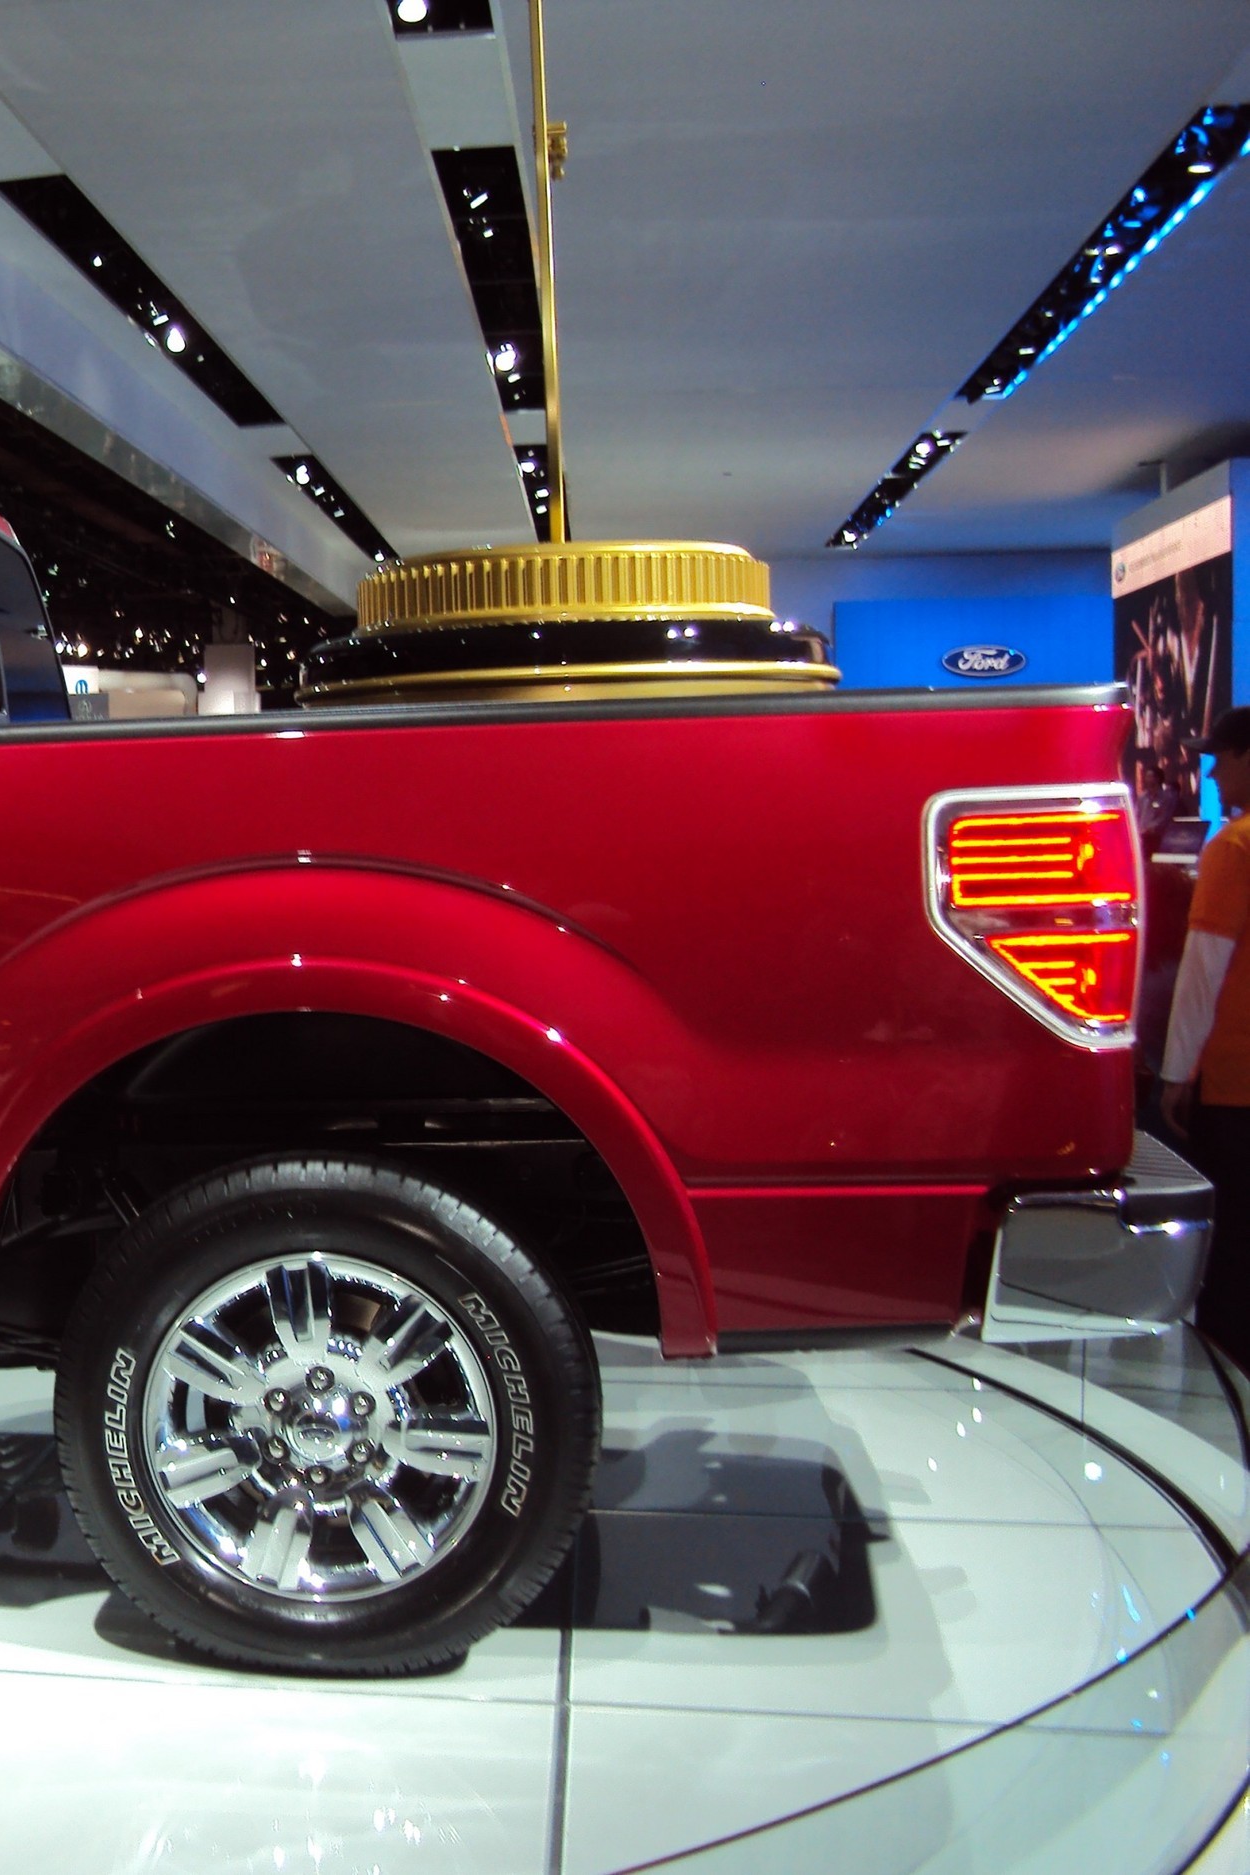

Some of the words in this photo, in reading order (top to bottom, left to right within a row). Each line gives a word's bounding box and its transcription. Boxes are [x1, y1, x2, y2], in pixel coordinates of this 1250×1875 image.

[958, 649, 1010, 670] Ford
[104, 1347, 181, 1566] MICHELIN
[458, 1292, 535, 1518] MICHELIN
